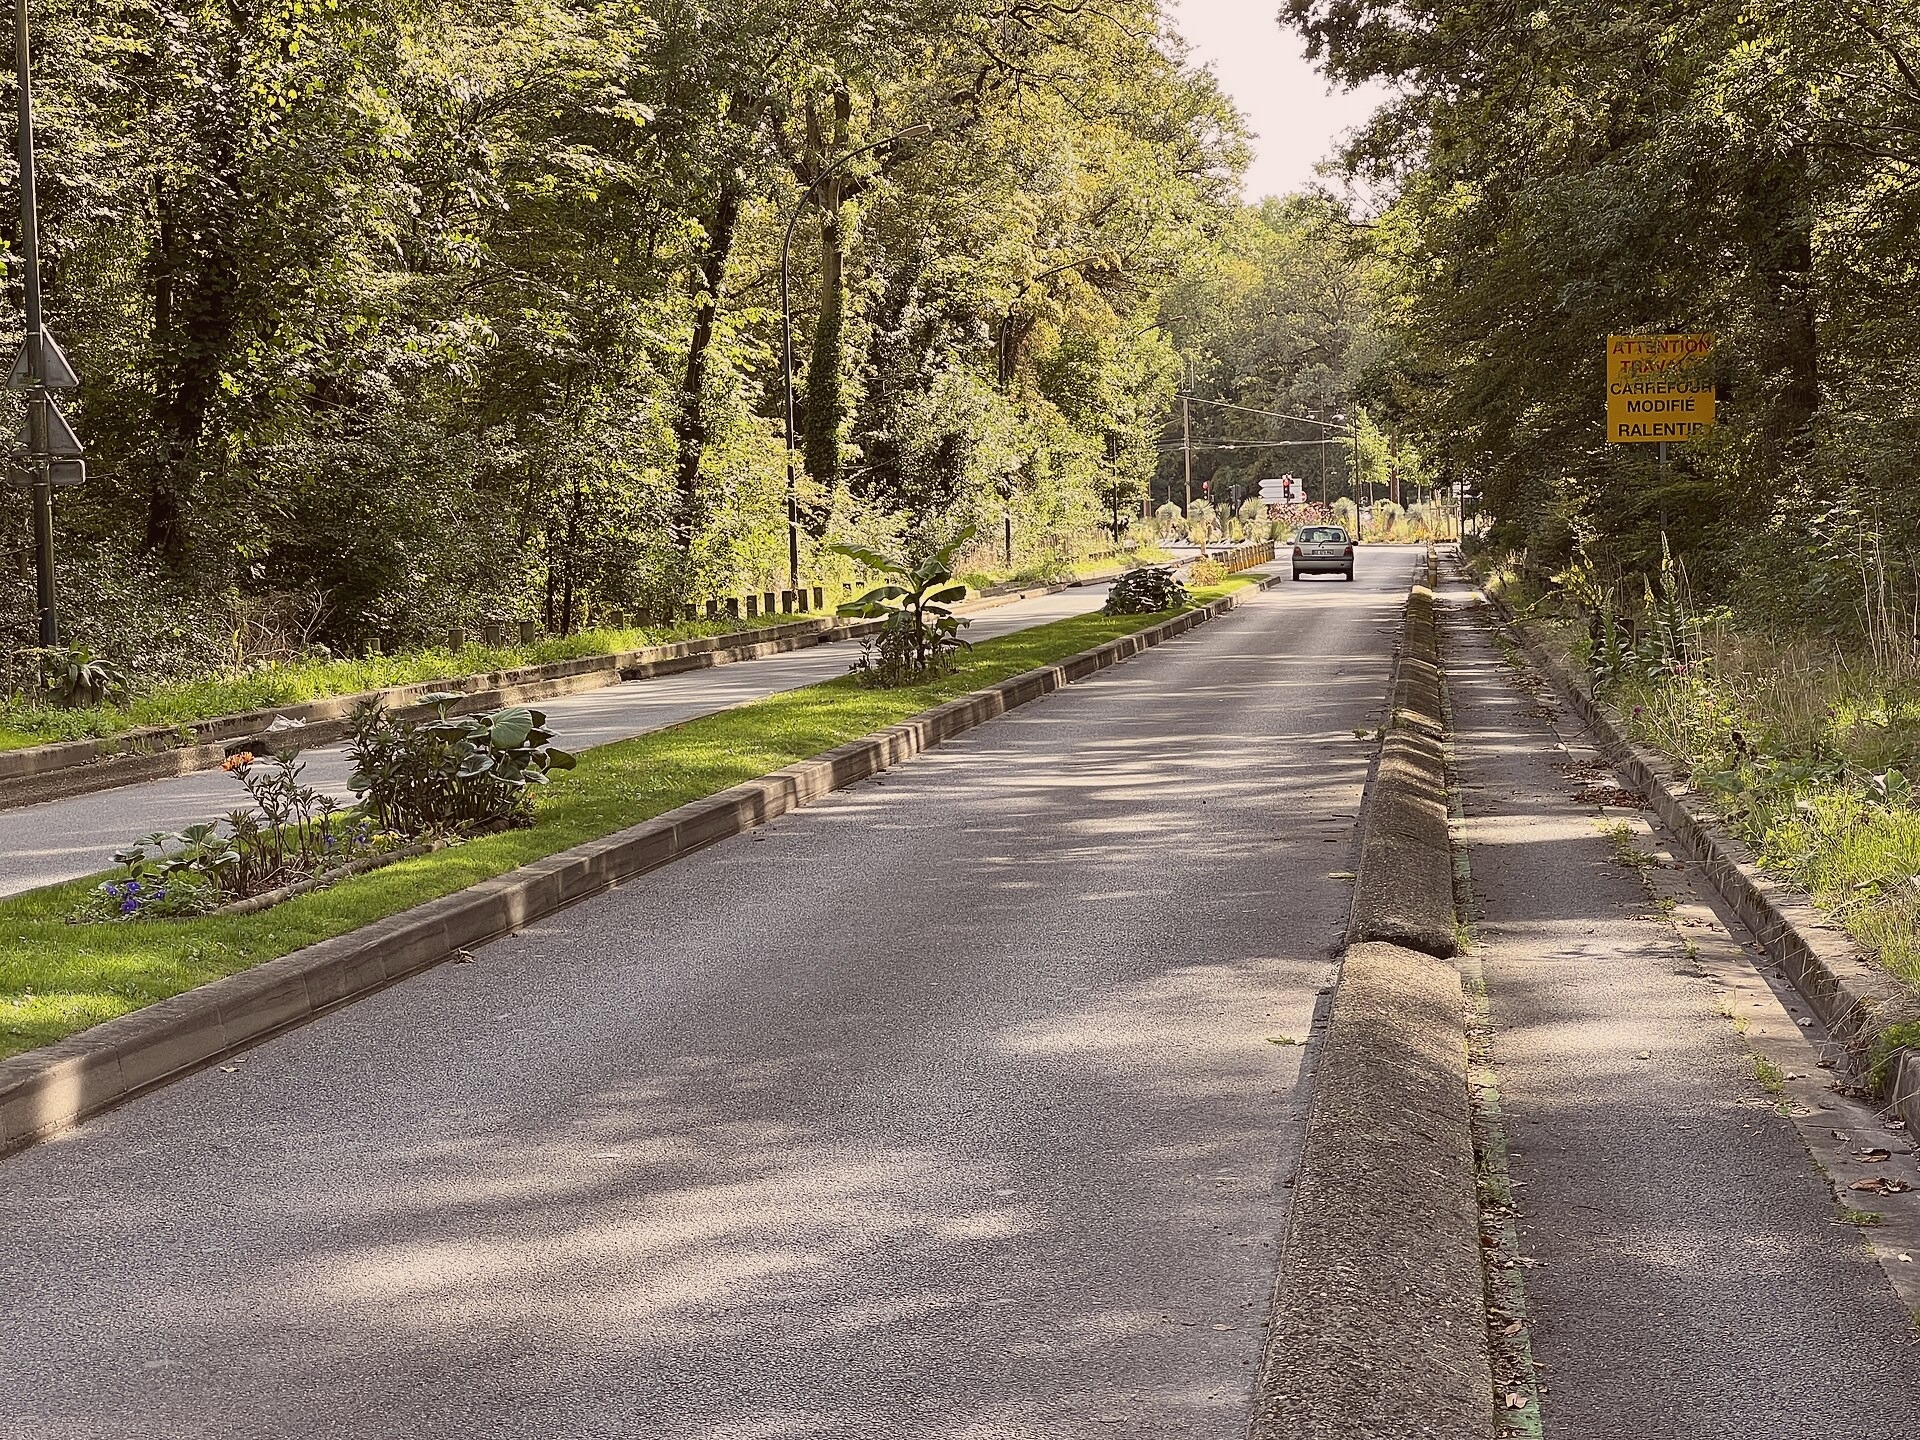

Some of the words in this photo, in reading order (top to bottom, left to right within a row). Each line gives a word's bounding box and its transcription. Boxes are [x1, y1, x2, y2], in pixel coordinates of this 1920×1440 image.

[1612, 338, 1712, 354] ATTENTION
[1610, 381, 1712, 395] CARREFOUR
[1627, 396, 1695, 412] MODIFIÉ
